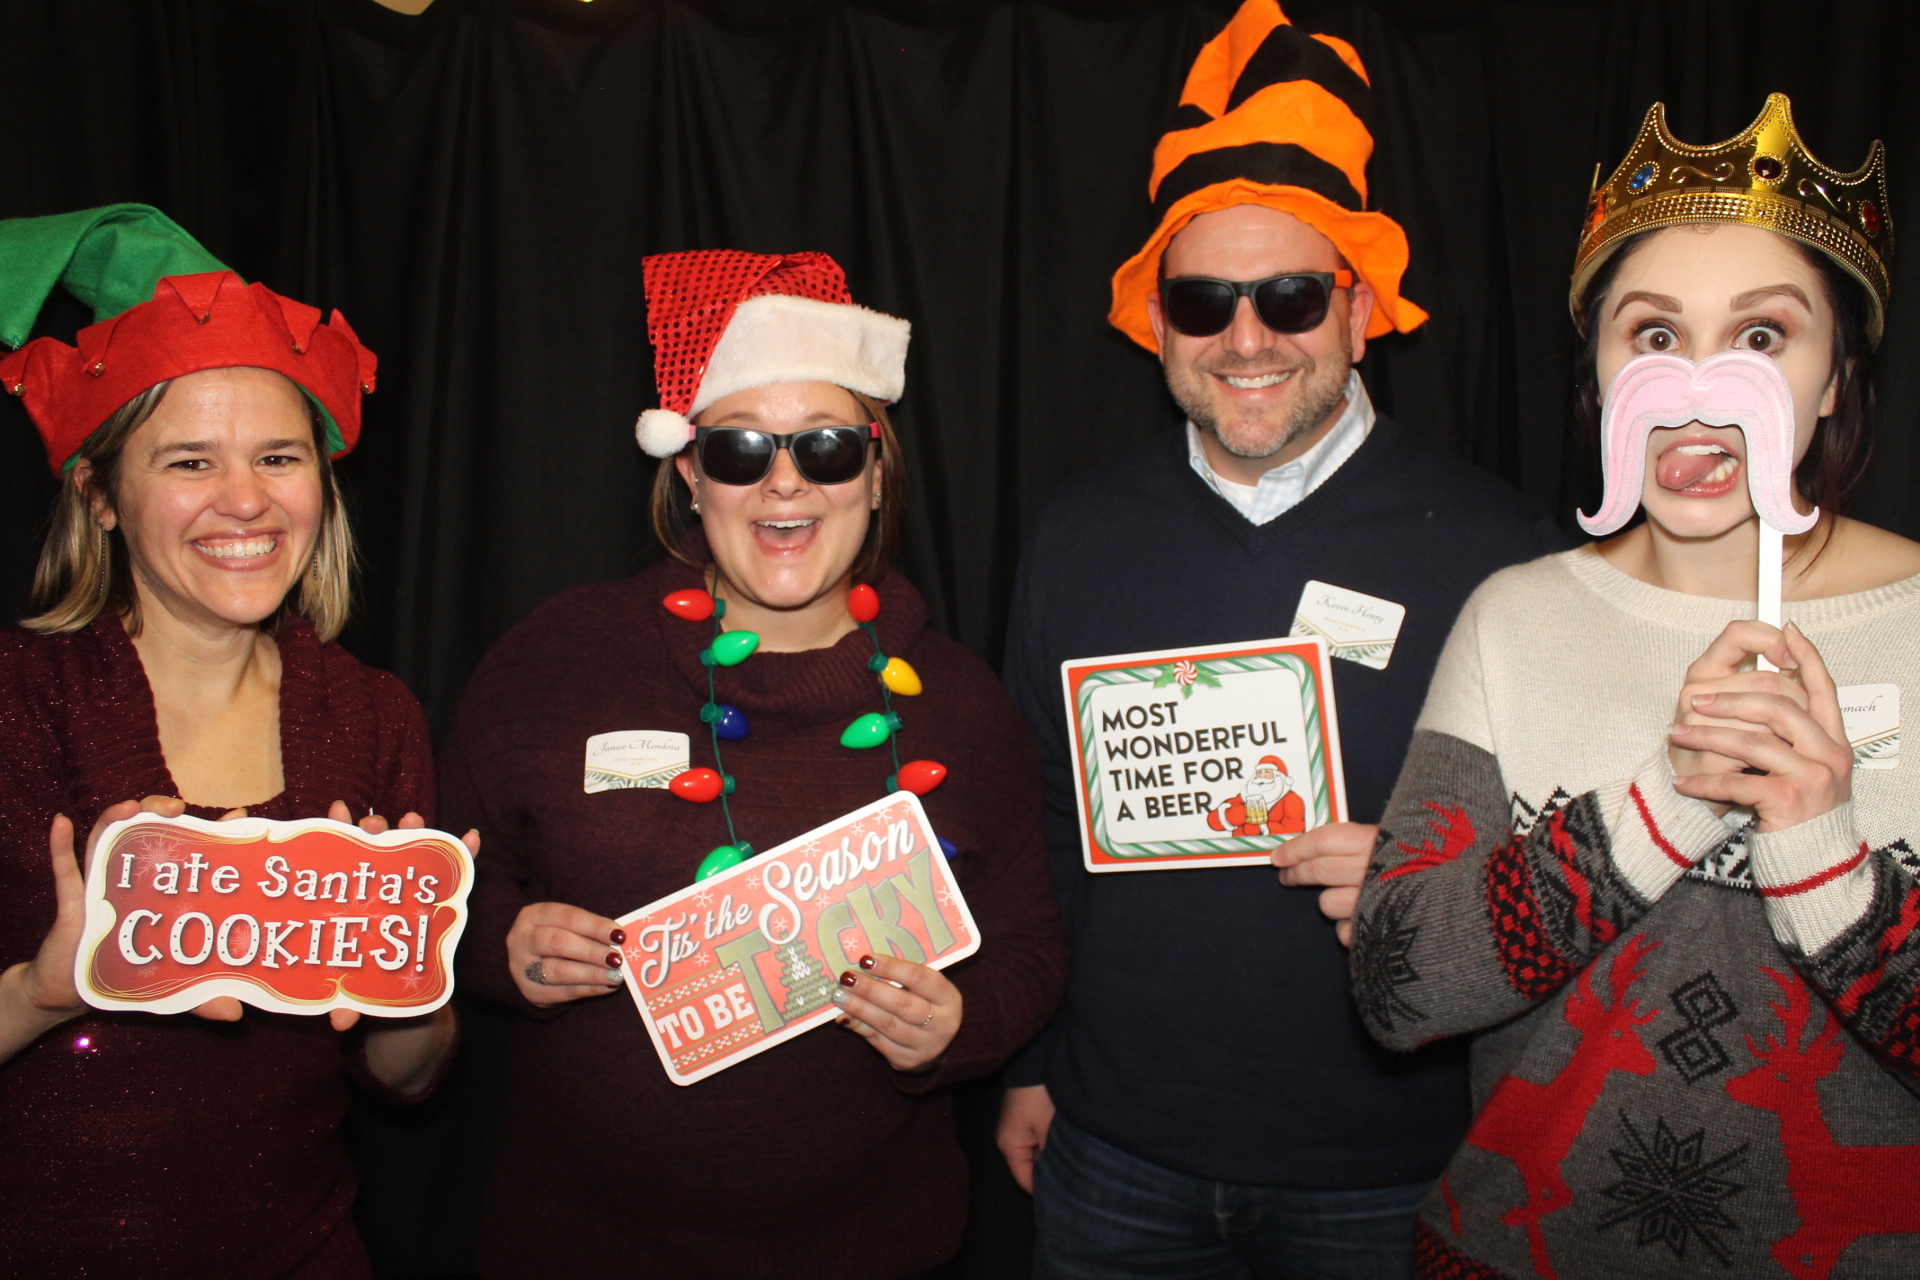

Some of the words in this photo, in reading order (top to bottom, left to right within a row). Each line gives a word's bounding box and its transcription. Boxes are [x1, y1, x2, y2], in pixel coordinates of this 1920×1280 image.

[1102, 701, 1179, 733] MOST
[1840, 694, 1883, 713] mach
[1104, 721, 1288, 762] WONDERFUL
[1109, 764, 1175, 792] TIME
[1183, 757, 1245, 785] FOR
[1116, 799, 1137, 823] A
[1144, 791, 1213, 820] BEER
[117, 853, 136, 888] I
[152, 852, 241, 895] ate
[257, 855, 440, 905] Santa's
[704, 894, 752, 939] the
[758, 819, 915, 945] Season
[117, 908, 430, 973] COOKIES!
[656, 1005, 704, 1050] TO
[704, 983, 757, 1029] BE
